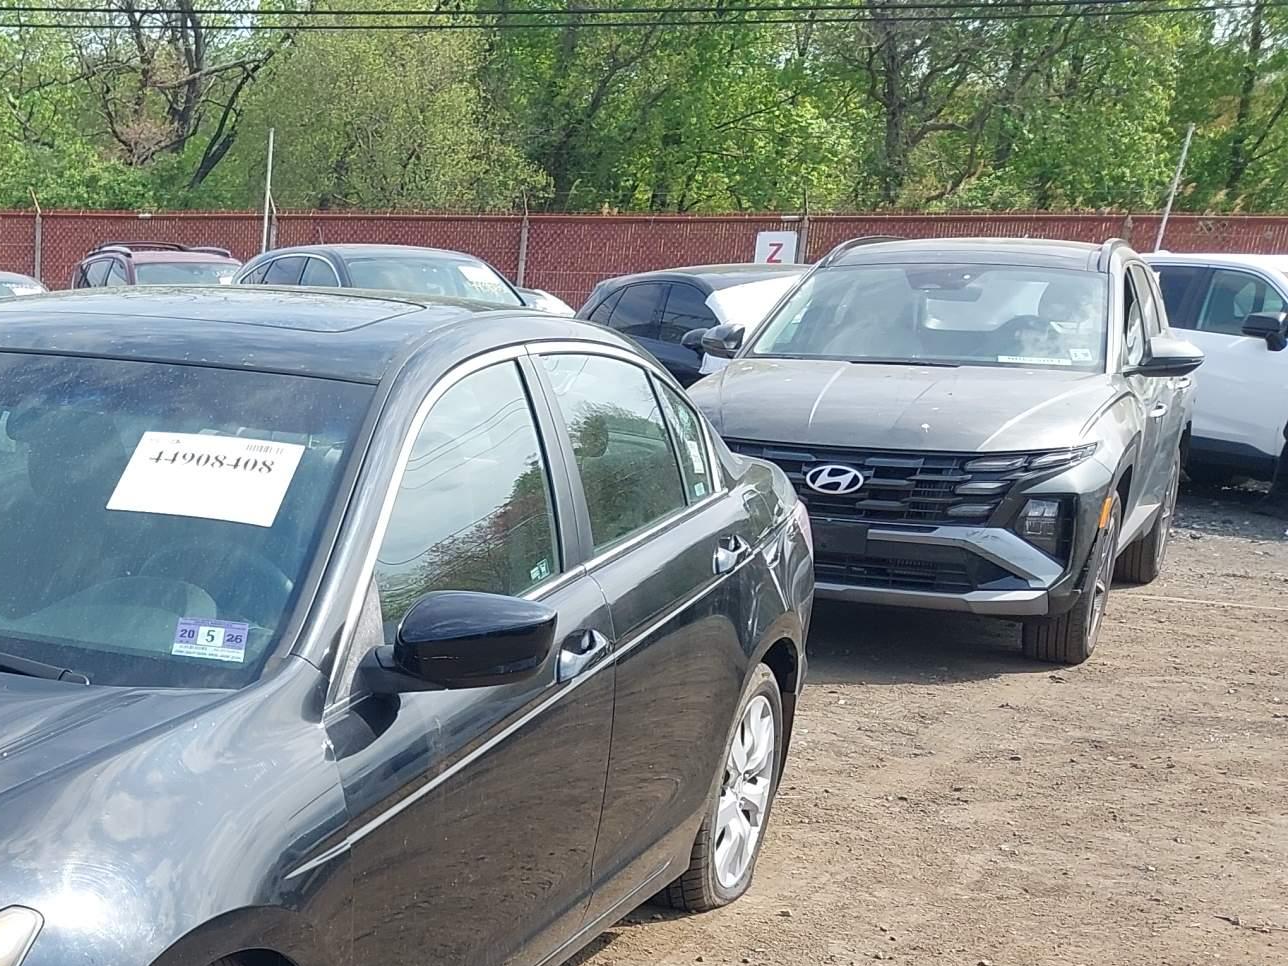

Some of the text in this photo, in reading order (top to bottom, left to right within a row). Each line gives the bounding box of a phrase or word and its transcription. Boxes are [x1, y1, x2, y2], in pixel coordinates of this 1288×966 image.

[766, 243, 783, 263] Z
[149, 450, 275, 474] 44908408
[179, 628, 195, 639] 20
[205, 629, 216, 643] 5
